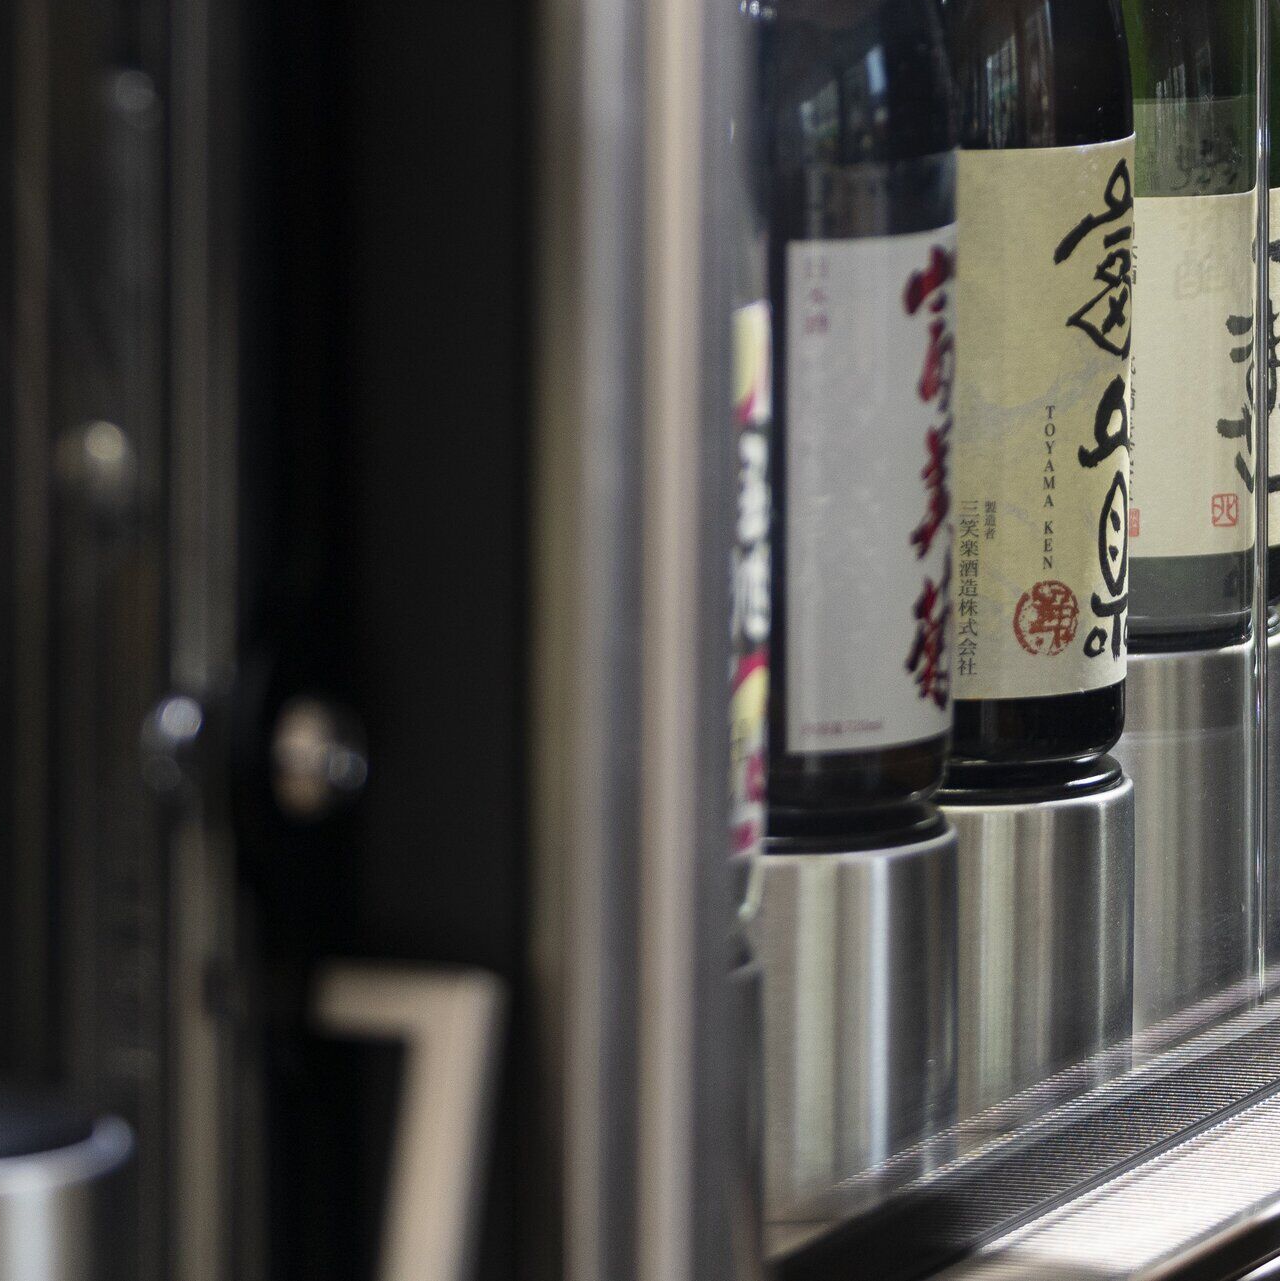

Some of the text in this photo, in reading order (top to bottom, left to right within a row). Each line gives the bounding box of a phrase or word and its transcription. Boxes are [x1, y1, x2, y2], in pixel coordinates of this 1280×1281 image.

[984, 500, 997, 540] 製造者
[1042, 405, 1056, 570] TOYAMA KEN
[957, 499, 980, 676] 三笑楽酒造株式会社
